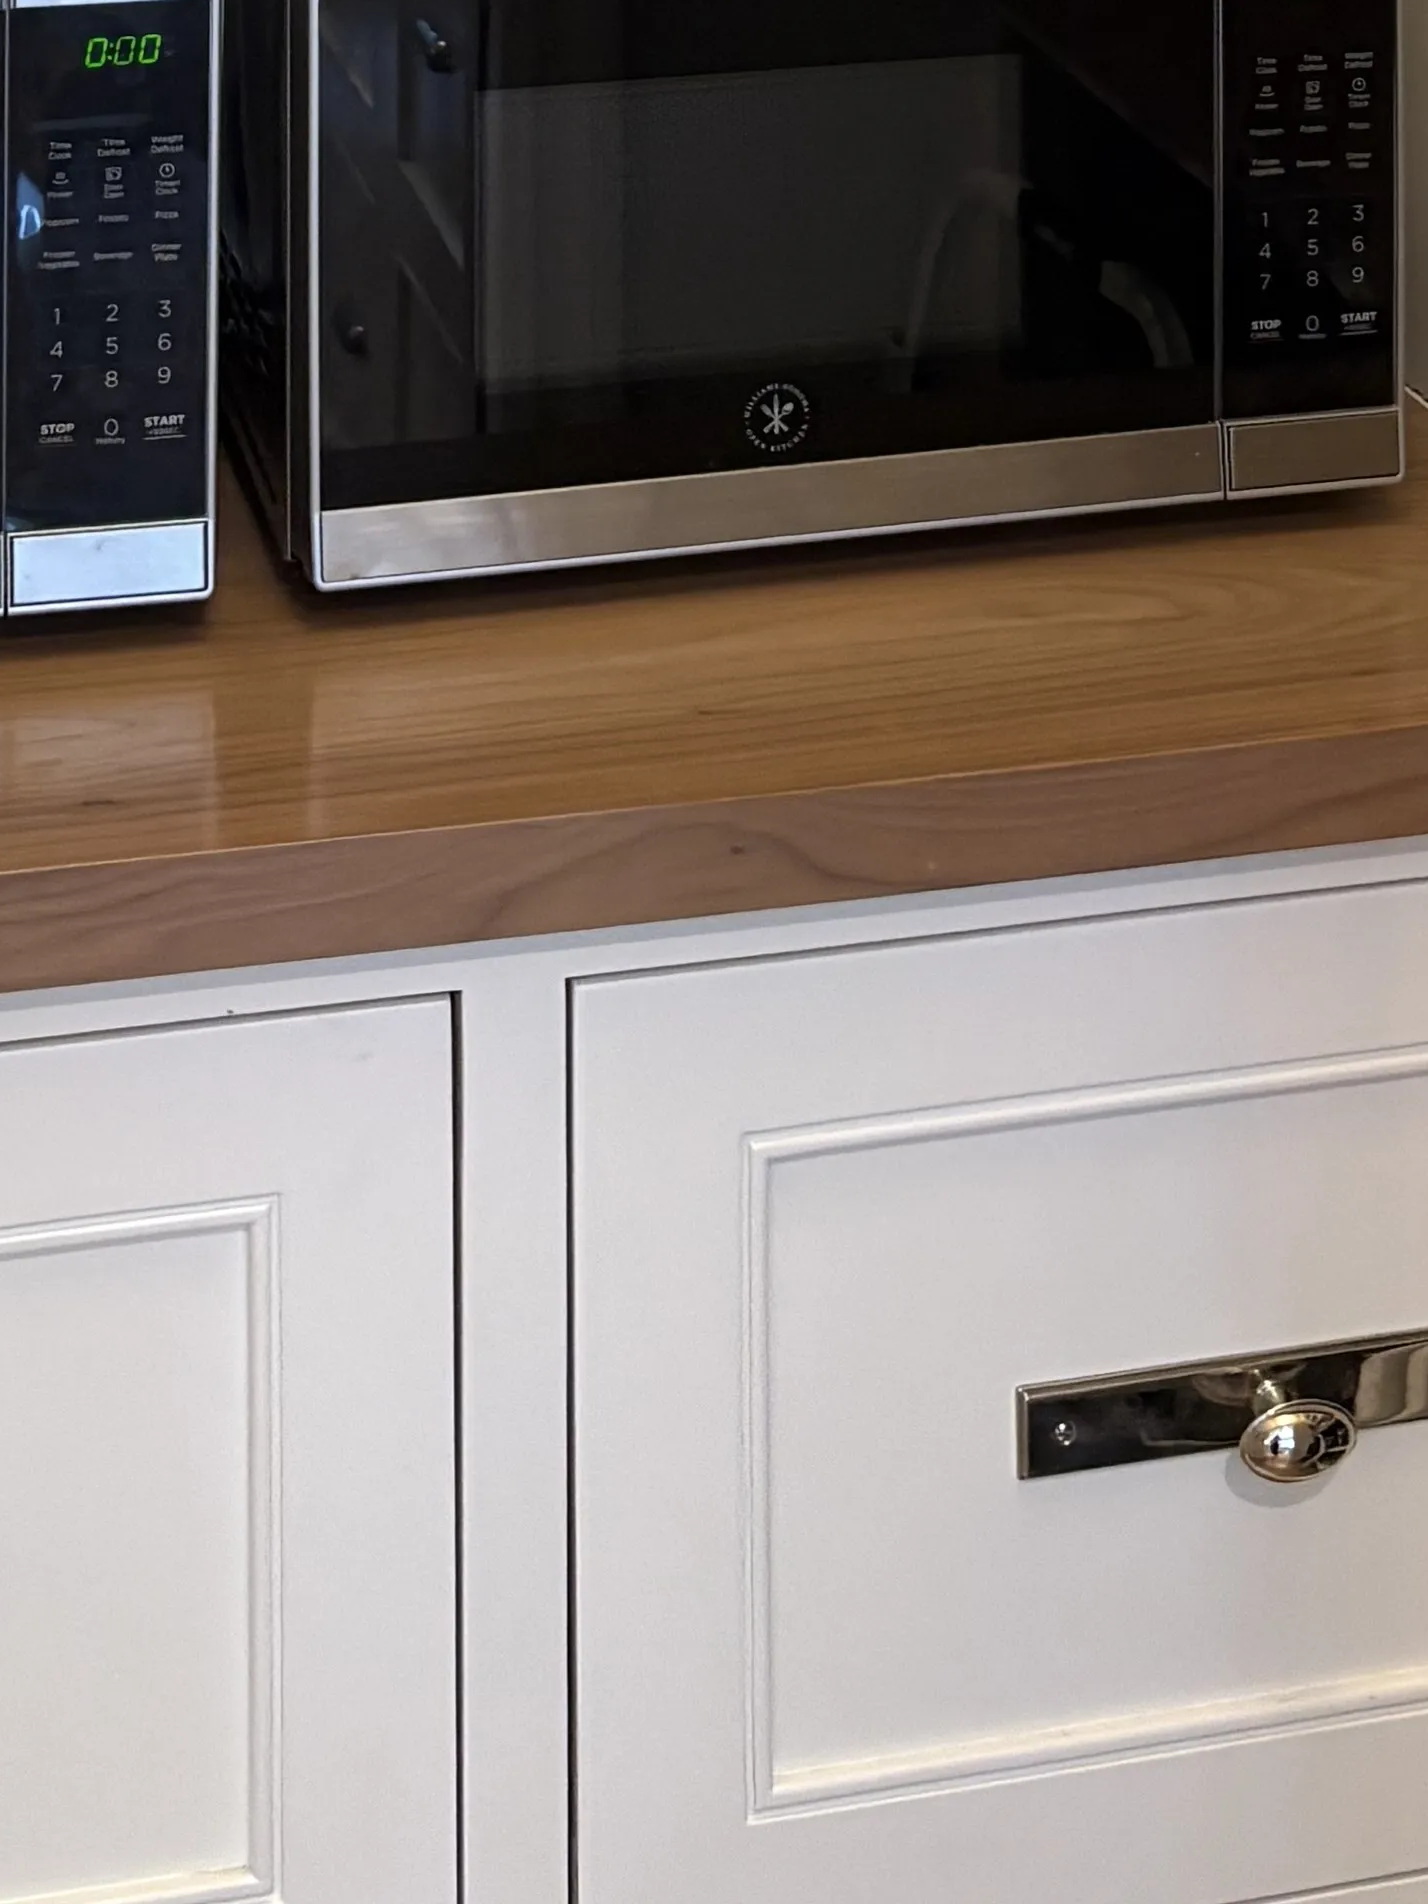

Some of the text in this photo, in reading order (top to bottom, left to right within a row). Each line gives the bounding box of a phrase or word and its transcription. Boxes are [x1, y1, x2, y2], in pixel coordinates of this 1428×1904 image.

[84, 33, 162, 69] 0:00
[1262, 203, 1365, 229] 1 2 3
[1258, 235, 1365, 260] 4 5 6
[1259, 266, 1365, 291] 7 8 9
[53, 298, 172, 326] 1 2 3
[1250, 310, 1378, 333] STOP 0 START
[49, 332, 172, 359] 4 5 6
[50, 366, 172, 393] 7 8 9
[39, 413, 186, 437] STOP 0 START
